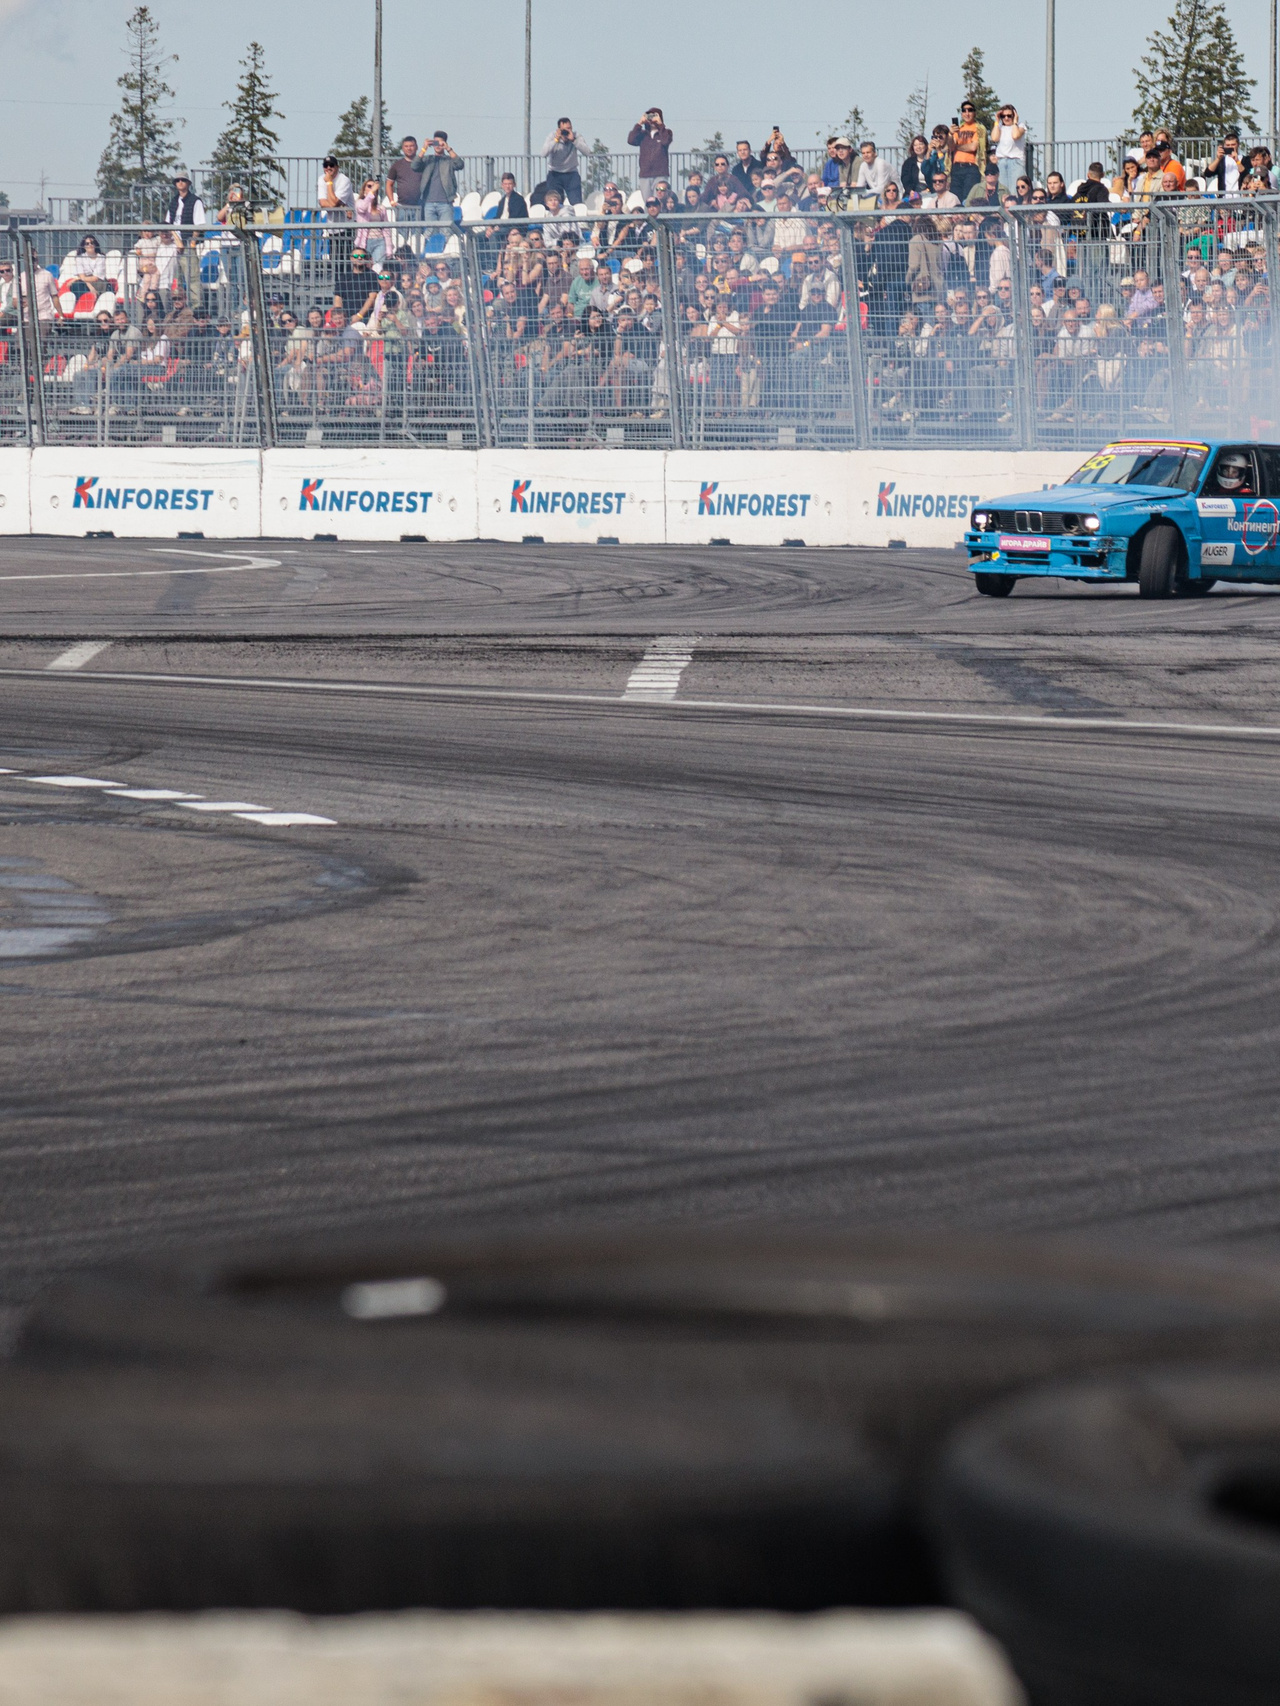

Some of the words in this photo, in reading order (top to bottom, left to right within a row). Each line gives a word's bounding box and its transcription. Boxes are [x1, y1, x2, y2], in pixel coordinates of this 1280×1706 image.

[73, 476, 214, 511] KINFOREST
[299, 478, 433, 513] KINFOREST
[510, 479, 626, 514] KINFOREST
[698, 481, 811, 517] KINFOREST
[1001, 539, 1022, 547] ИГОРА
[1022, 539, 1047, 548] ДРАЙВ
